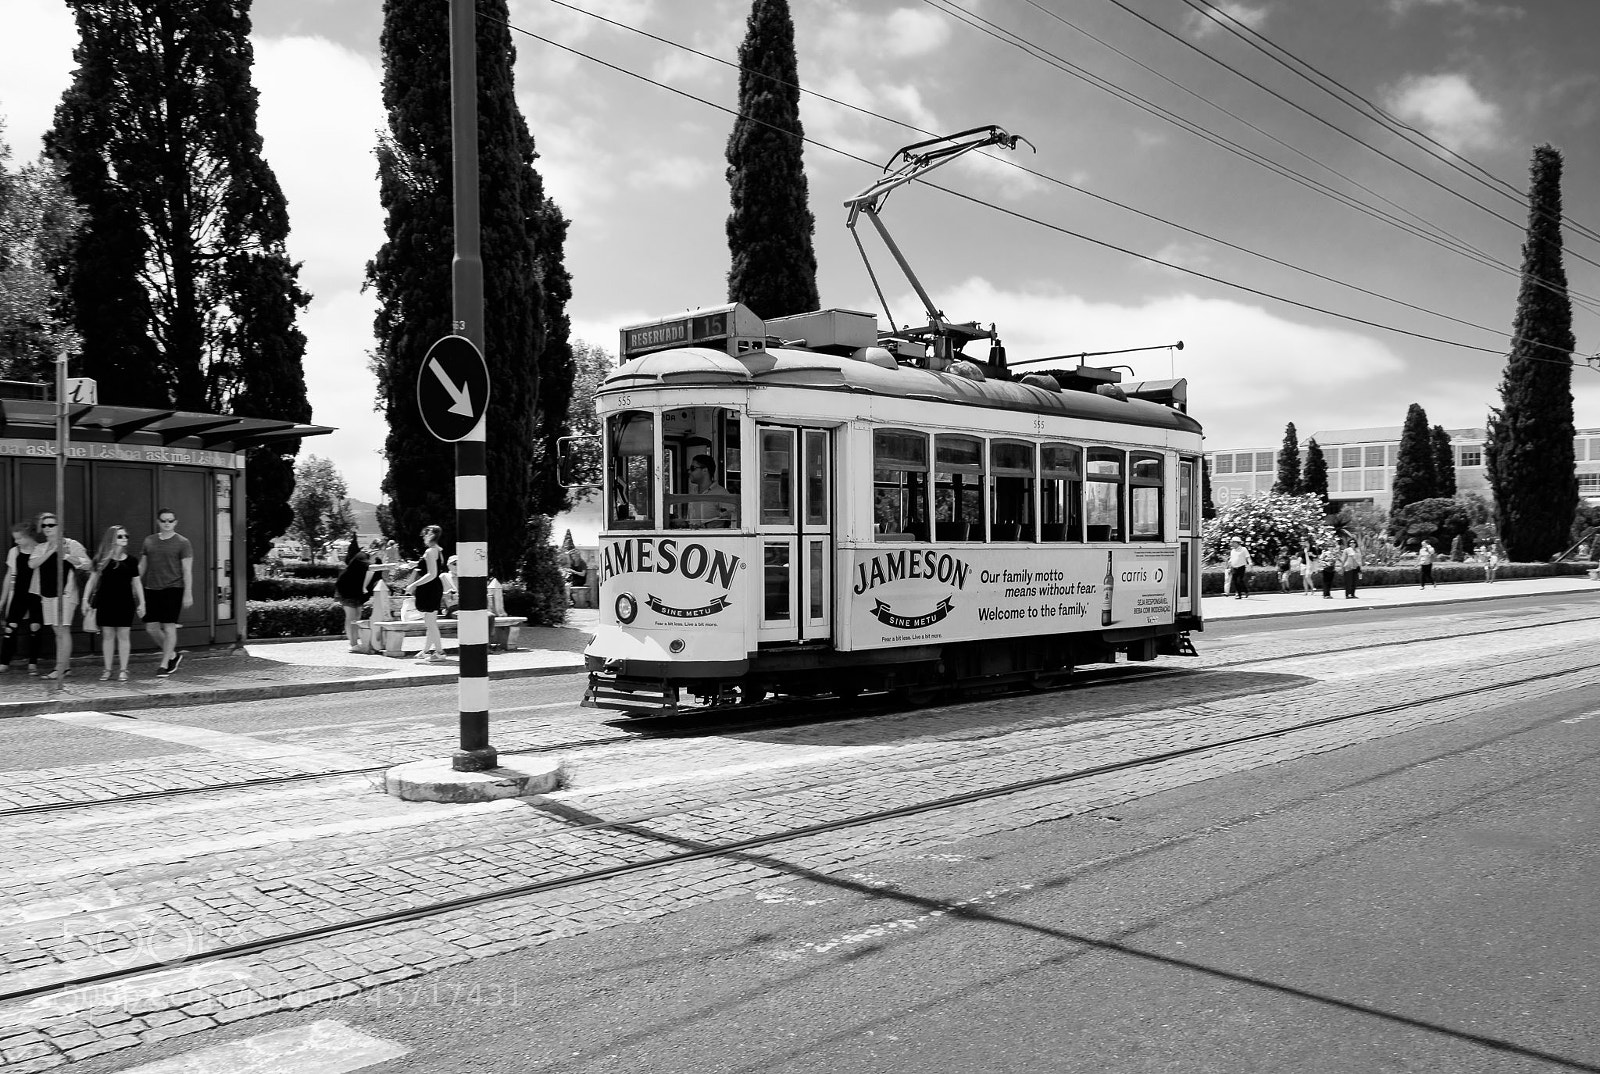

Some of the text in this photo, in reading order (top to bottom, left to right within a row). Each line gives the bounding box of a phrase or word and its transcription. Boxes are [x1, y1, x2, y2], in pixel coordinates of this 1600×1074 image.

[631, 317, 722, 347] RESERVADO 15
[618, 395, 632, 407] 555
[1033, 419, 1045, 430] 555
[26, 441, 57, 456] ask
[145, 447, 170, 462] ask
[171, 453, 191, 463] me
[854, 550, 969, 595] JAMESON
[980, 568, 1064, 585] Our family motto
[1121, 567, 1147, 582] carris
[1005, 587, 1037, 598] means
[1039, 582, 1075, 596] without
[1076, 581, 1097, 595] fear.
[661, 607, 711, 617] SINE METU
[978, 602, 1088, 621] Welcome to the family.
[889, 614, 937, 627] SINE METU
